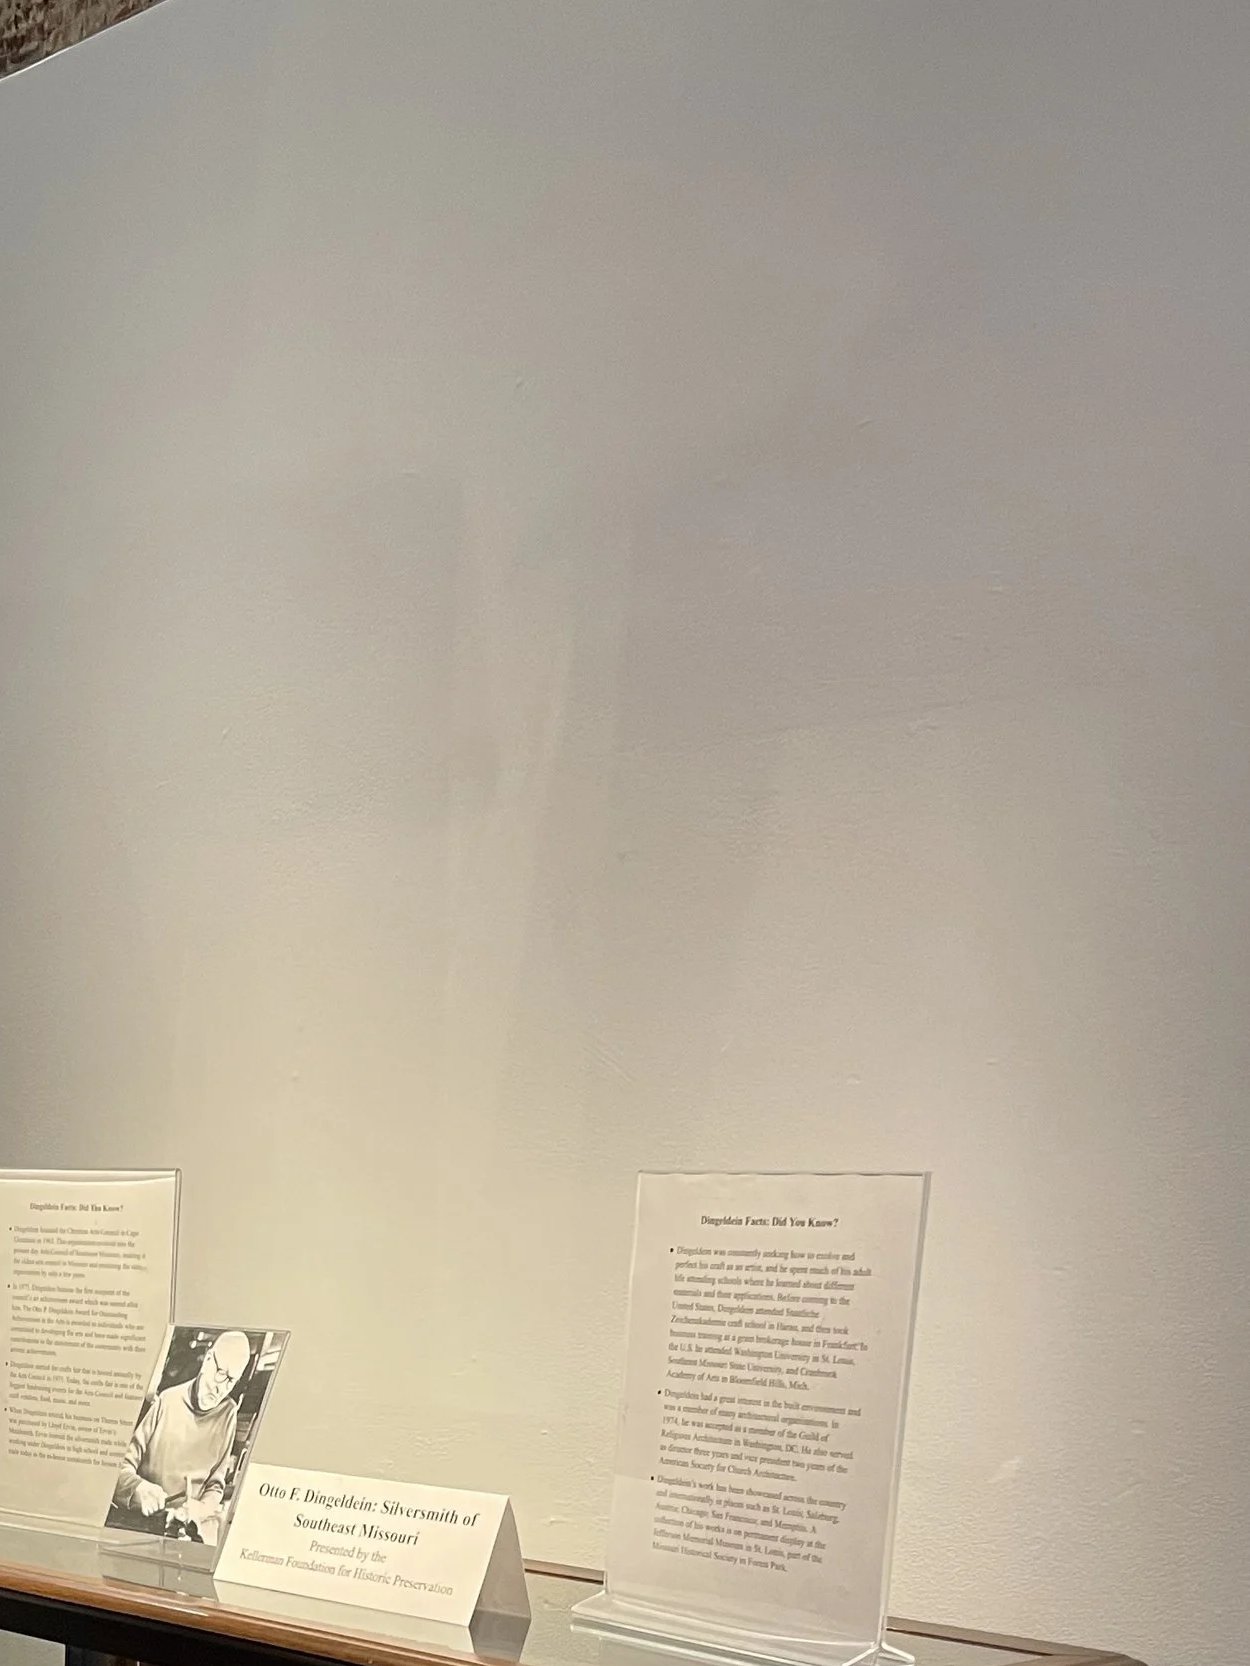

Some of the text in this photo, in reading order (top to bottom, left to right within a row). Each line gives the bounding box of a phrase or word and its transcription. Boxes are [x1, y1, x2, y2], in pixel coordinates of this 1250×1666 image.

[744, 1216, 769, 1225] Facts:
[771, 1217, 787, 1226] Did
[788, 1217, 805, 1226] You
[807, 1218, 838, 1227] Know?
[259, 1483, 480, 1527] Otto F. Dingeldein: Silversmith of
[294, 1514, 420, 1546] Southeast Missouri
[309, 1540, 387, 1563] Presented by the
[240, 1548, 453, 1596] Kellerman Foundation for Historic Preservation
